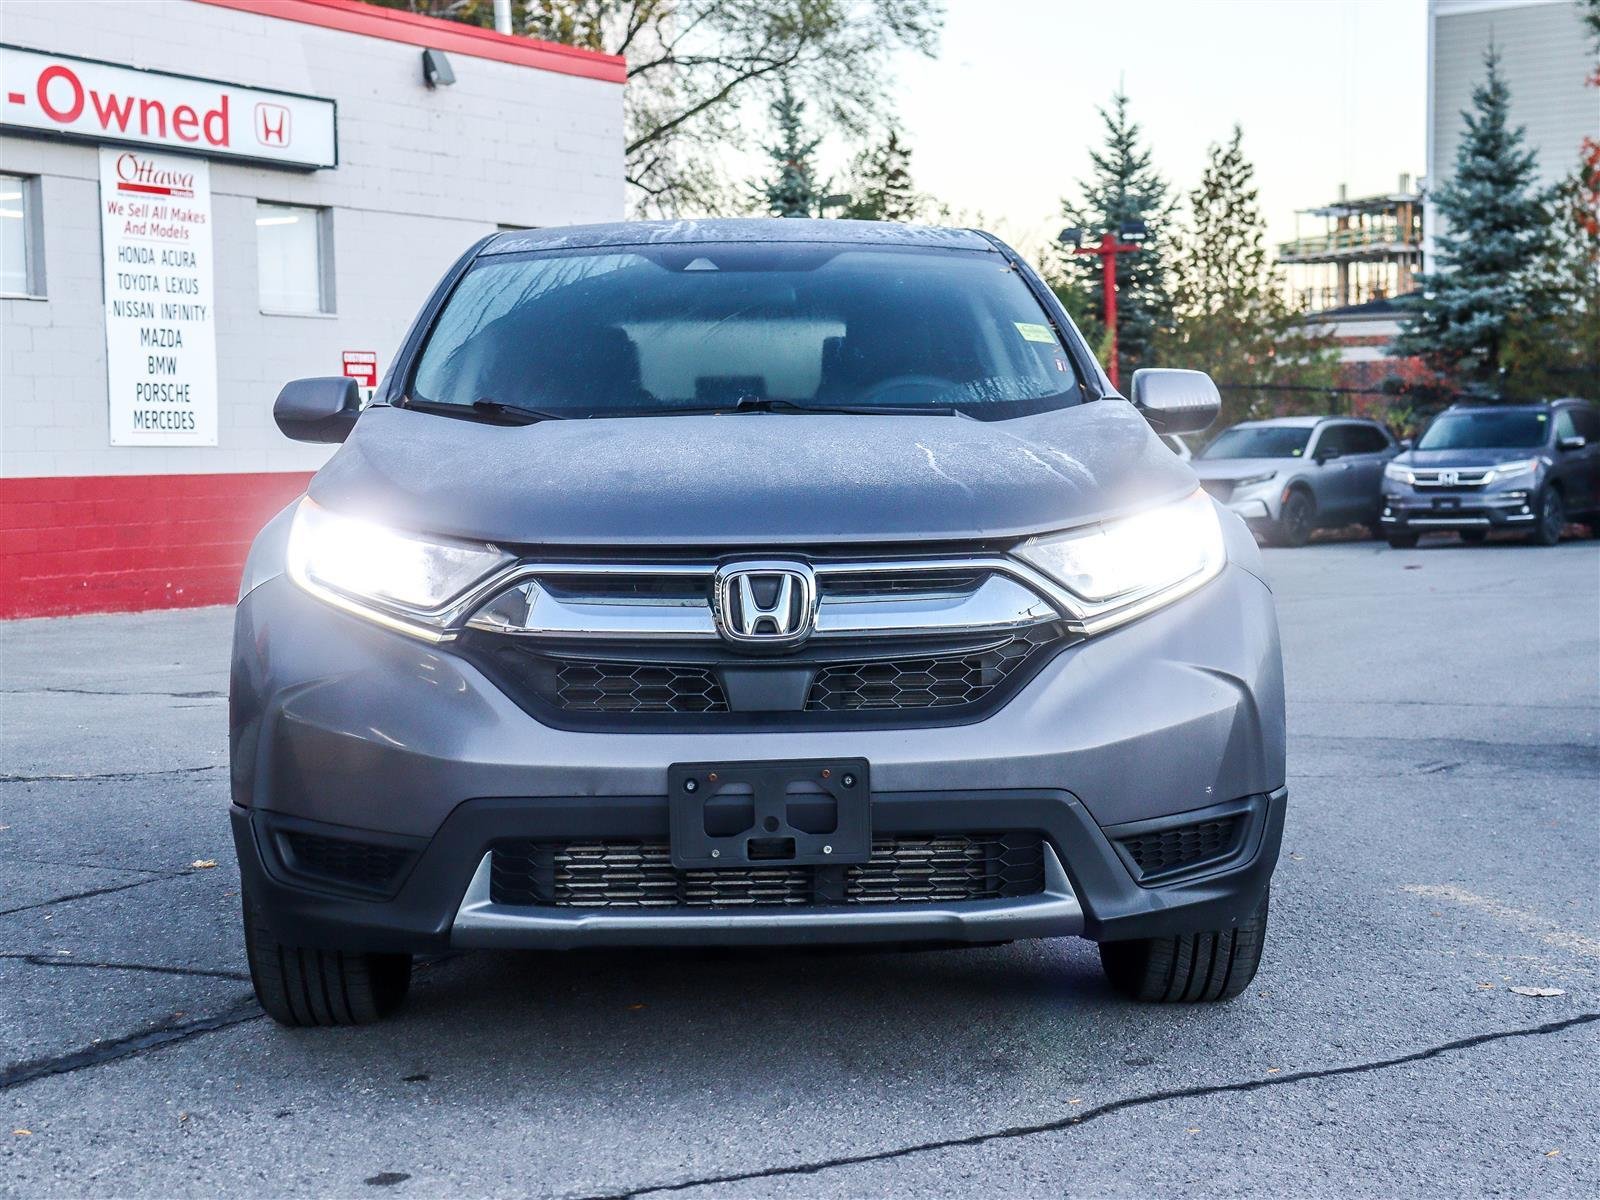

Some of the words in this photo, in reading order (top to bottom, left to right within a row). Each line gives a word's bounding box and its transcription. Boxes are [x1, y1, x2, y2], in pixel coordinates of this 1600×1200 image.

[117, 152, 194, 188] Ottawa
[107, 201, 125, 216] We
[127, 202, 149, 218] Sell
[152, 206, 167, 220] All
[170, 208, 206, 224] Makes
[123, 220, 146, 235] And
[149, 223, 190, 240] Models
[118, 245, 155, 265] HONDA
[161, 249, 197, 268] ACURA
[117, 273, 160, 292] TOYOTA
[165, 276, 199, 295] LEXUS
[113, 300, 154, 318] NISSAN
[161, 303, 207, 321] INFINITY
[140, 327, 183, 348] MAZDA
[148, 355, 177, 375] BMW
[136, 382, 191, 403] PORSCHE
[134, 410, 195, 430] MERCEDES
